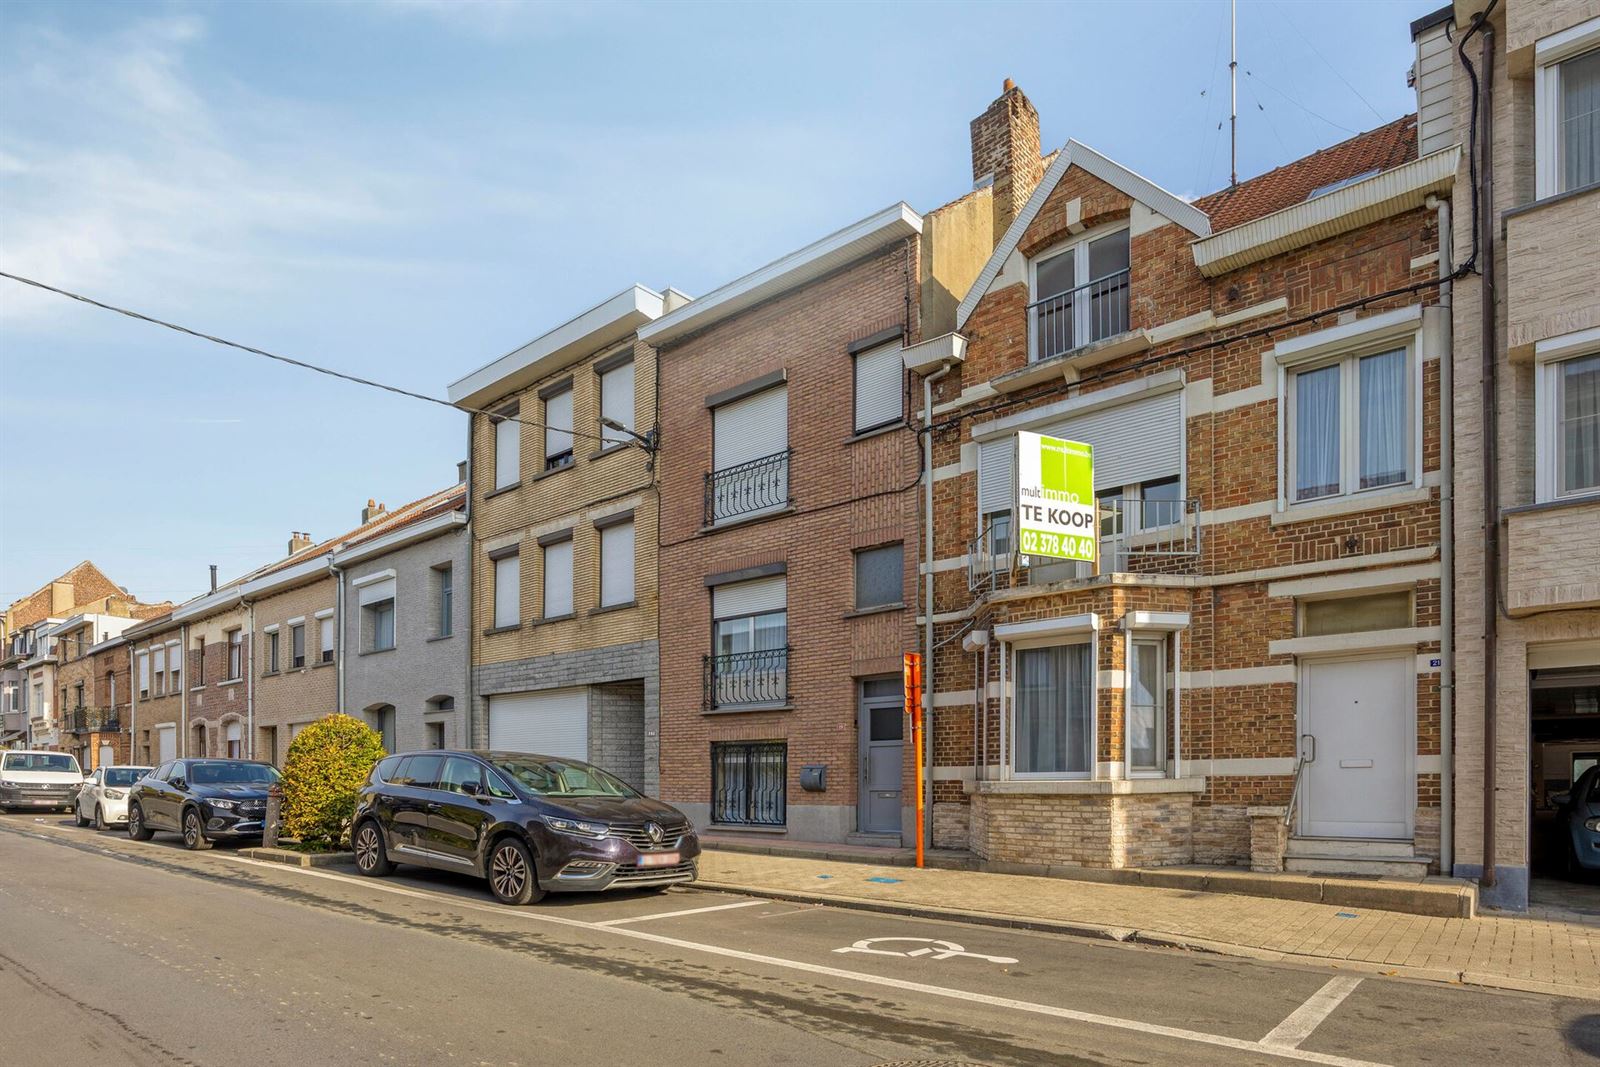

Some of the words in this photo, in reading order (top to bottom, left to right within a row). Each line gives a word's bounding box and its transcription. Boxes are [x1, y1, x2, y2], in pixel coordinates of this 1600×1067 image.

[1021, 504, 1042, 522] TE
[1048, 508, 1093, 528] KOOP
[1023, 531, 1037, 551] 02
[1040, 533, 1059, 554] 378
[1062, 537, 1076, 556] 40
[1079, 539, 1093, 558] 40
